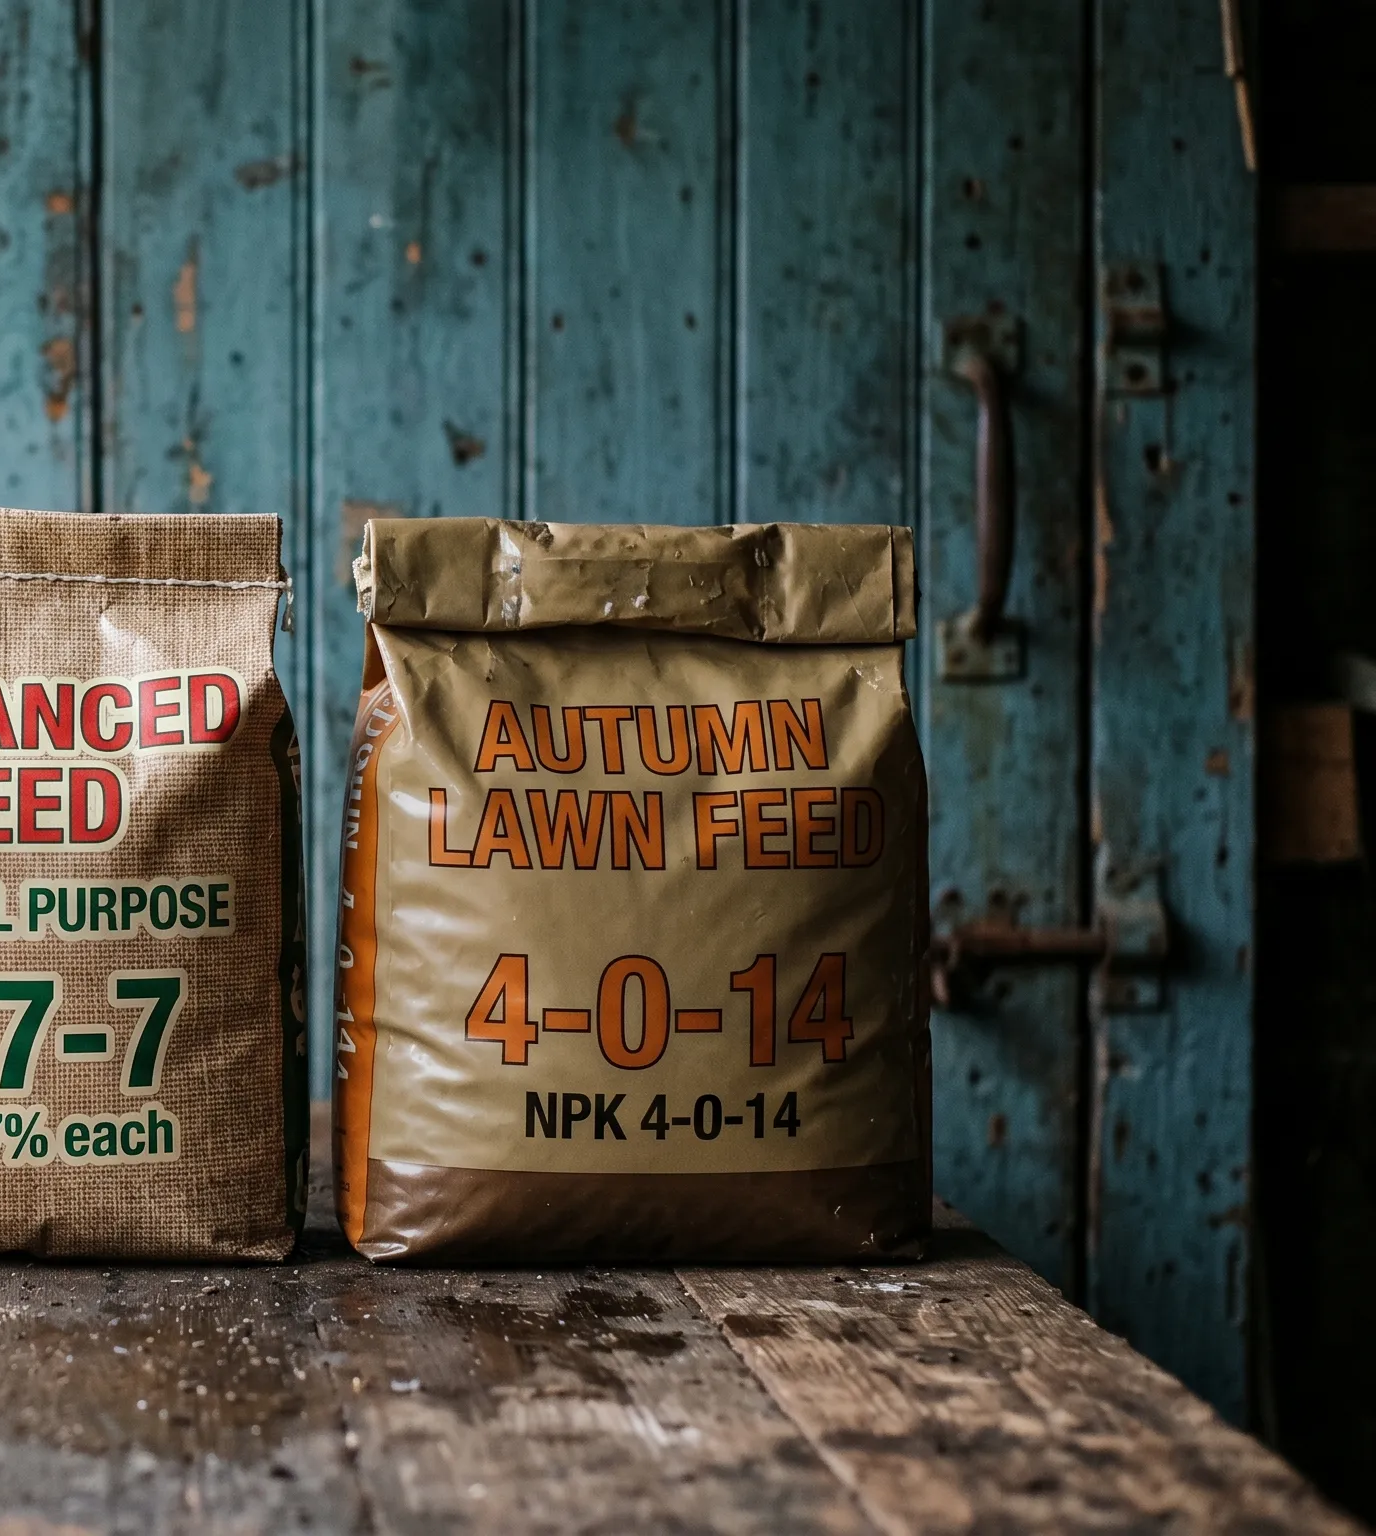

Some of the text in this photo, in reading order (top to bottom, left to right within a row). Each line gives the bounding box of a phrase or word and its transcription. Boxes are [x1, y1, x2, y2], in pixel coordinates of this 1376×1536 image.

[474, 698, 830, 775] AUTUMN
[427, 786, 886, 871] LAWN FEED
[28, 884, 230, 932] PURPOSE
[464, 952, 856, 1071] 4-0-14
[64, 1111, 174, 1156] each
[524, 1091, 802, 1141] NPK 4-0-14
